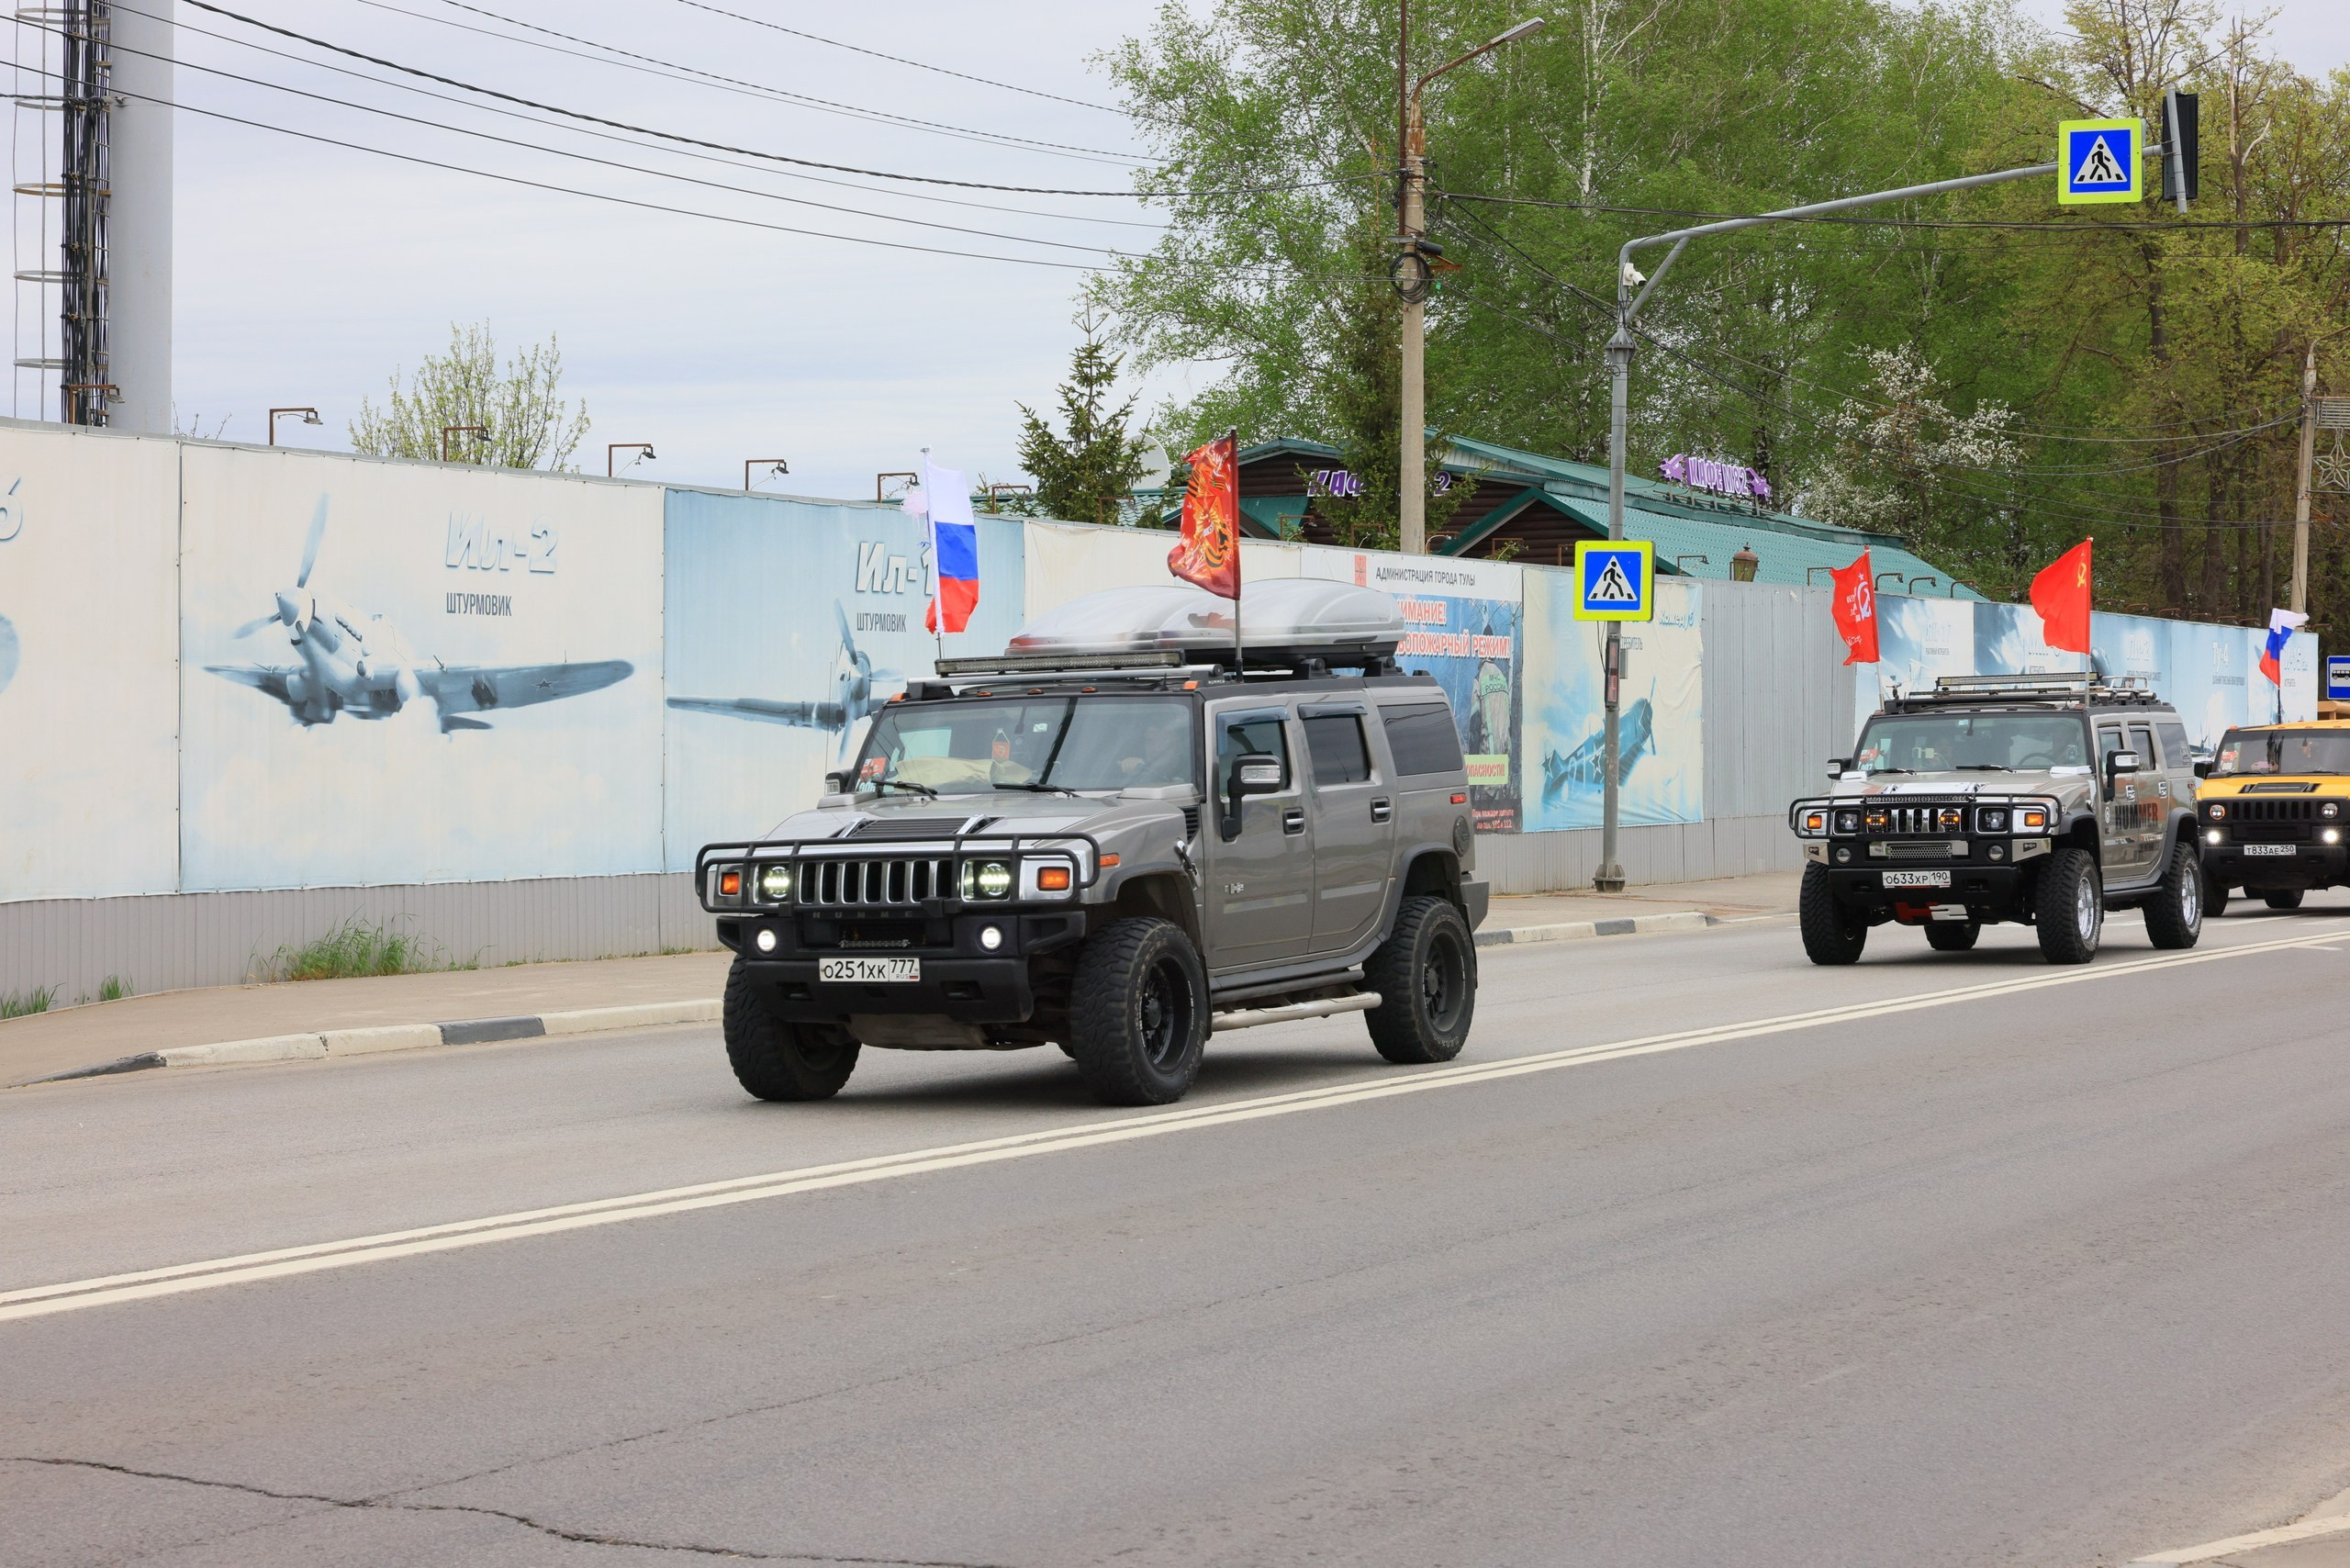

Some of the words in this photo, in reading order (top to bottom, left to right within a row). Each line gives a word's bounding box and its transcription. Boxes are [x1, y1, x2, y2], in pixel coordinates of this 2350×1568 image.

[1689, 457, 1723, 491] КАФЕ
[1722, 464, 1749, 496] М82
[445, 510, 559, 574] Ил-2
[1375, 566, 1433, 585] АДМИНИСТРАЦИЯ
[1434, 570, 1458, 586] ГОРОДА
[1459, 574, 1476, 587] ТУЛЫ
[446, 592, 512, 616] ШТУРМОВИК
[1397, 599, 1447, 625] ИМАНИЕ!
[856, 612, 907, 633] ШТУРМОВИК
[1472, 634, 1511, 660] РЕЖИМ!
[2114, 802, 2159, 830] HUMMER
[2246, 846, 2279, 855] Т833АЕ
[1886, 873, 1929, 884] О633ХР
[1930, 872, 1947, 880] 190
[823, 960, 886, 979] О251ХК
[890, 959, 915, 974] 777
